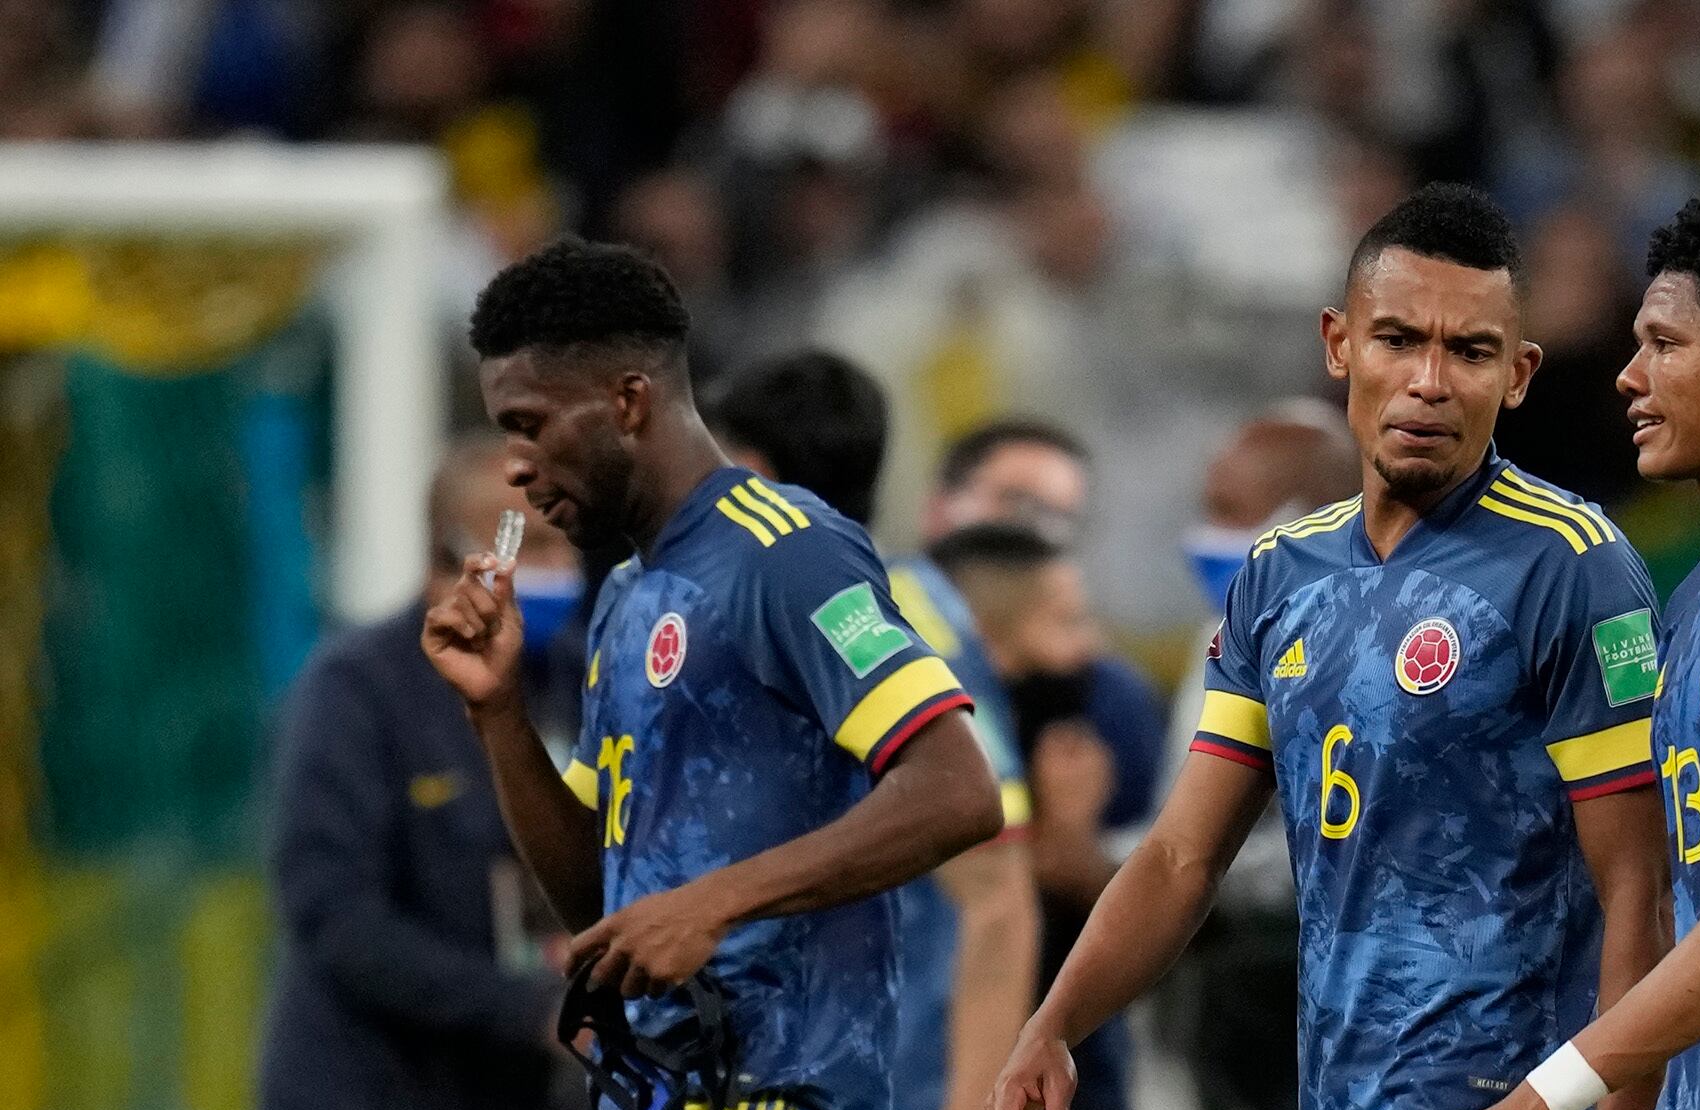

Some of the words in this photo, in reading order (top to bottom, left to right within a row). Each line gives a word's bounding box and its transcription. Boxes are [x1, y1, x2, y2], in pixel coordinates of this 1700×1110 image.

[1273, 664, 1308, 680] adidas
[1641, 659, 1657, 673] FIF
[1320, 725, 1361, 840] 6
